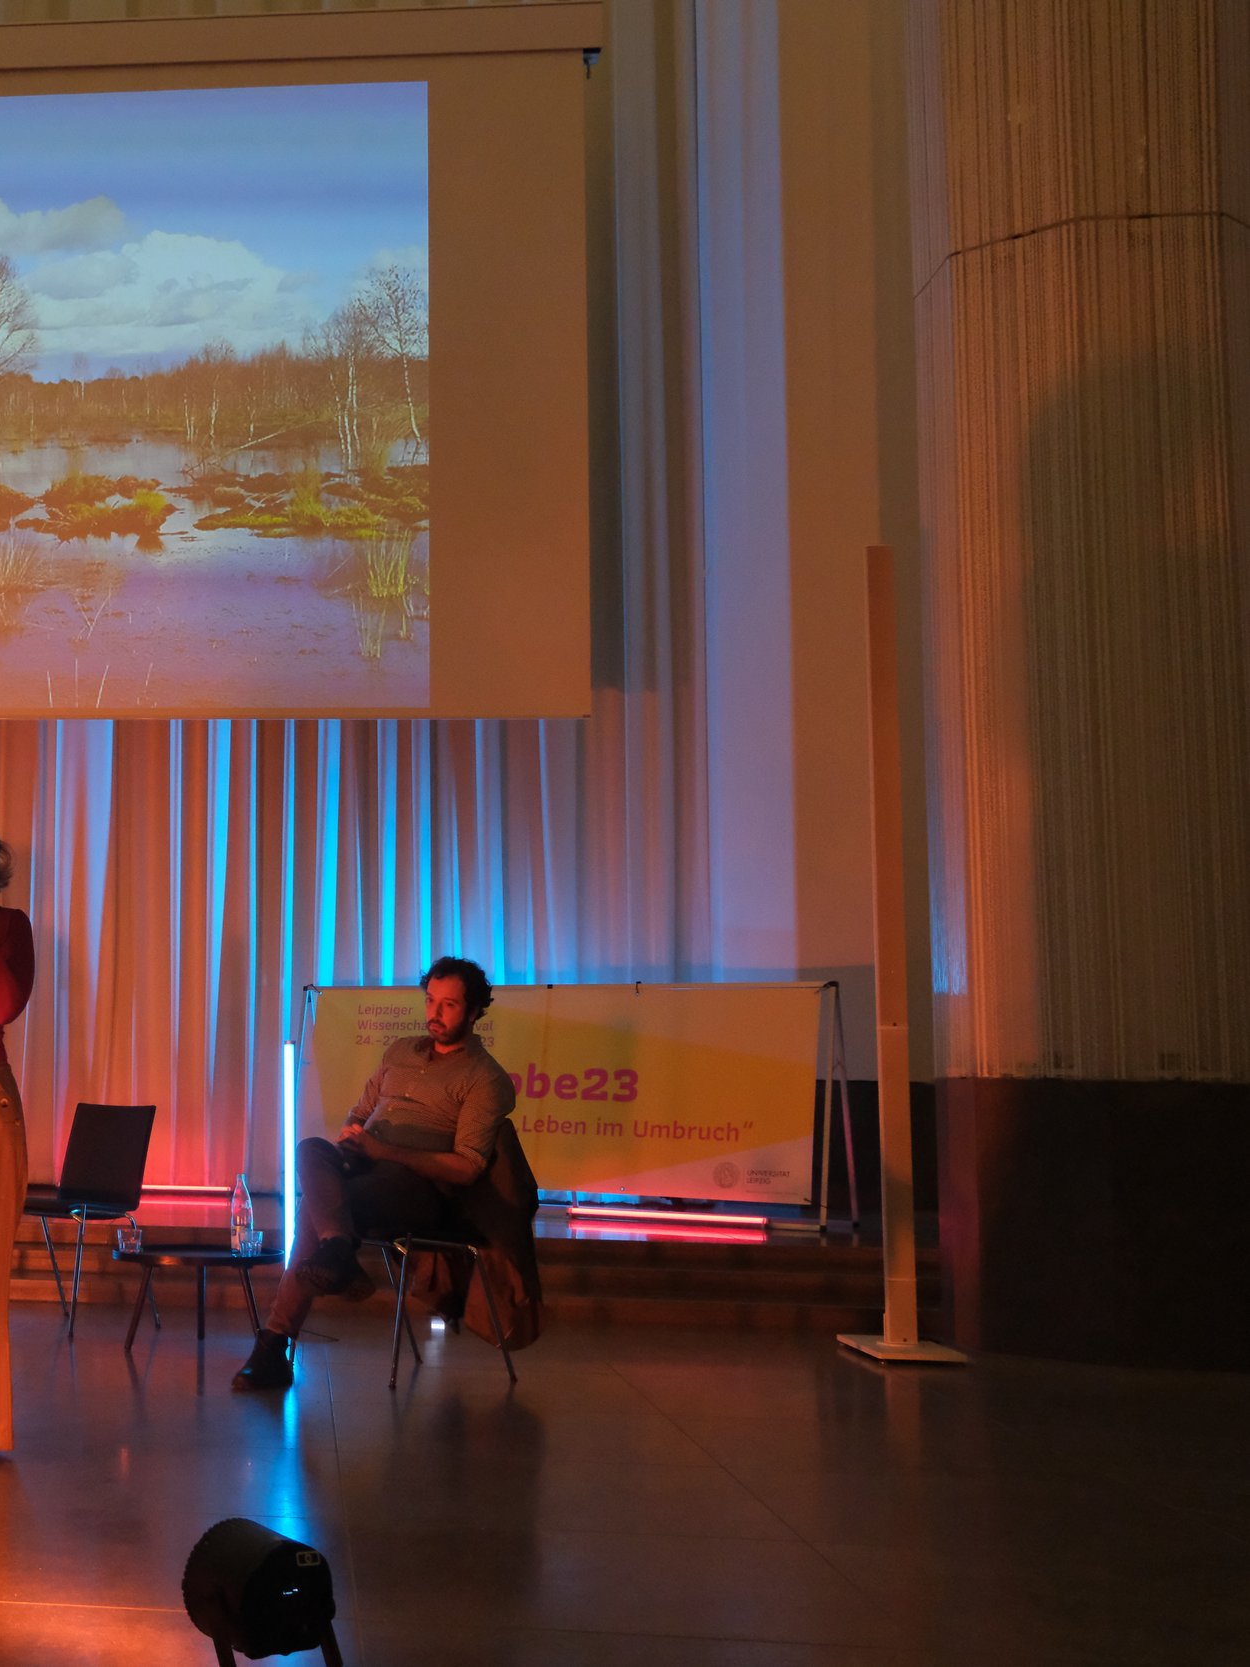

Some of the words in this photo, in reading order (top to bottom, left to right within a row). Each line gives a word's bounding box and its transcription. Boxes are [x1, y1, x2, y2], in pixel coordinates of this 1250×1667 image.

[358, 1004, 414, 1017] Leipziger
[509, 1063, 639, 1102] be23
[596, 1118, 623, 1137] im
[746, 1177, 771, 1185] LEIPZIG
